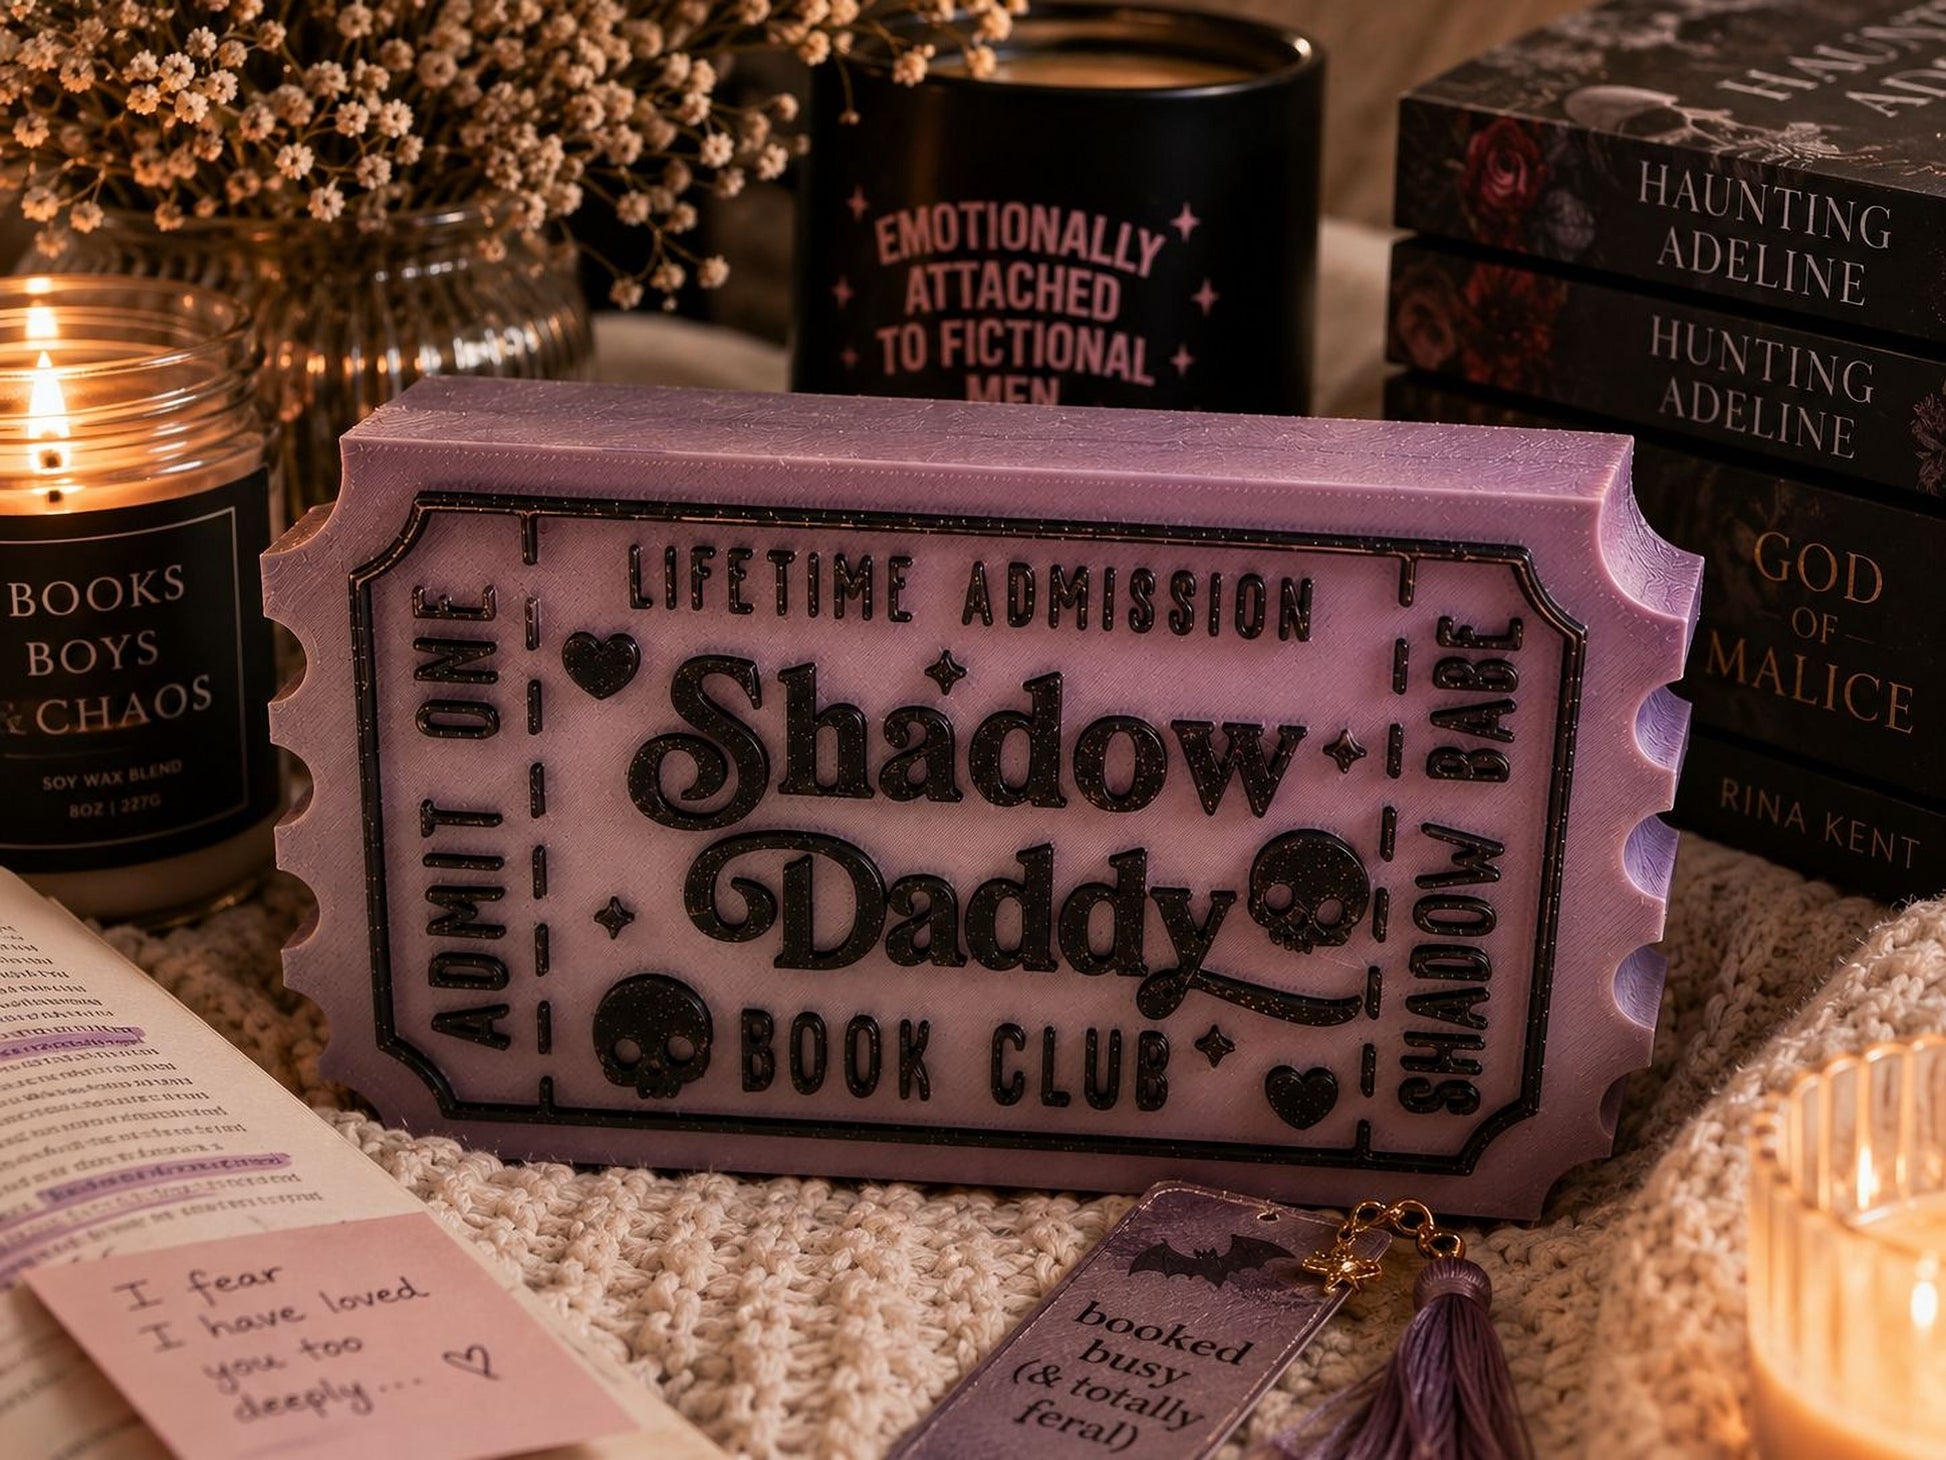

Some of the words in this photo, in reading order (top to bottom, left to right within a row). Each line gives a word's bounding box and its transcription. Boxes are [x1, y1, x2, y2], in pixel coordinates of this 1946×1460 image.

[874, 200, 1166, 279] EMOTIONALLY
[1639, 160, 1891, 250] HAUNTING
[904, 260, 1121, 324] ATTACHED
[1657, 226, 1866, 307] ADELINE
[876, 327, 927, 376] TO
[940, 319, 1156, 388] FICTIONAL
[1650, 315, 1875, 404] HUNTING
[1658, 376, 1856, 460] ADELINE
[8, 563, 185, 618] BOOKS
[628, 544, 914, 623] LIFETIME
[961, 560, 1314, 643] ADMISSION
[1753, 531, 1884, 604] GOD
[26, 629, 159, 677] BOYS
[411, 583, 501, 740] ONE
[1791, 607, 1839, 645] OF
[36, 674, 213, 736] CHAOS
[1424, 615, 1524, 784] BABE
[1705, 629, 1914, 735] MALICE
[42, 774, 78, 791] SOY
[83, 770, 123, 788] WAX
[129, 759, 183, 782] BLEND
[628, 653, 1308, 832] Shadow
[1720, 777, 1807, 835] RINA
[1825, 811, 1921, 871] KENT
[419, 798, 511, 1051] ADMIT
[684, 828, 1364, 1027] Daddy
[1398, 821, 1505, 1116] SHADOW
[740, 1008, 931, 1102] BOOK
[990, 1022, 1171, 1112] CLUB
[112, 1278, 164, 1312] I
[187, 1266, 284, 1307] fear
[139, 1320, 187, 1353] I
[199, 1303, 307, 1338] have
[319, 1275, 431, 1314] loved
[202, 1352, 287, 1395] you
[300, 1336, 363, 1361] too
[1074, 1301, 1255, 1367] booked
[1078, 1339, 1192, 1390] busy
[1012, 1358, 1064, 1389] (&
[1069, 1376, 1206, 1433] totally
[1013, 1398, 1140, 1454] feral)
